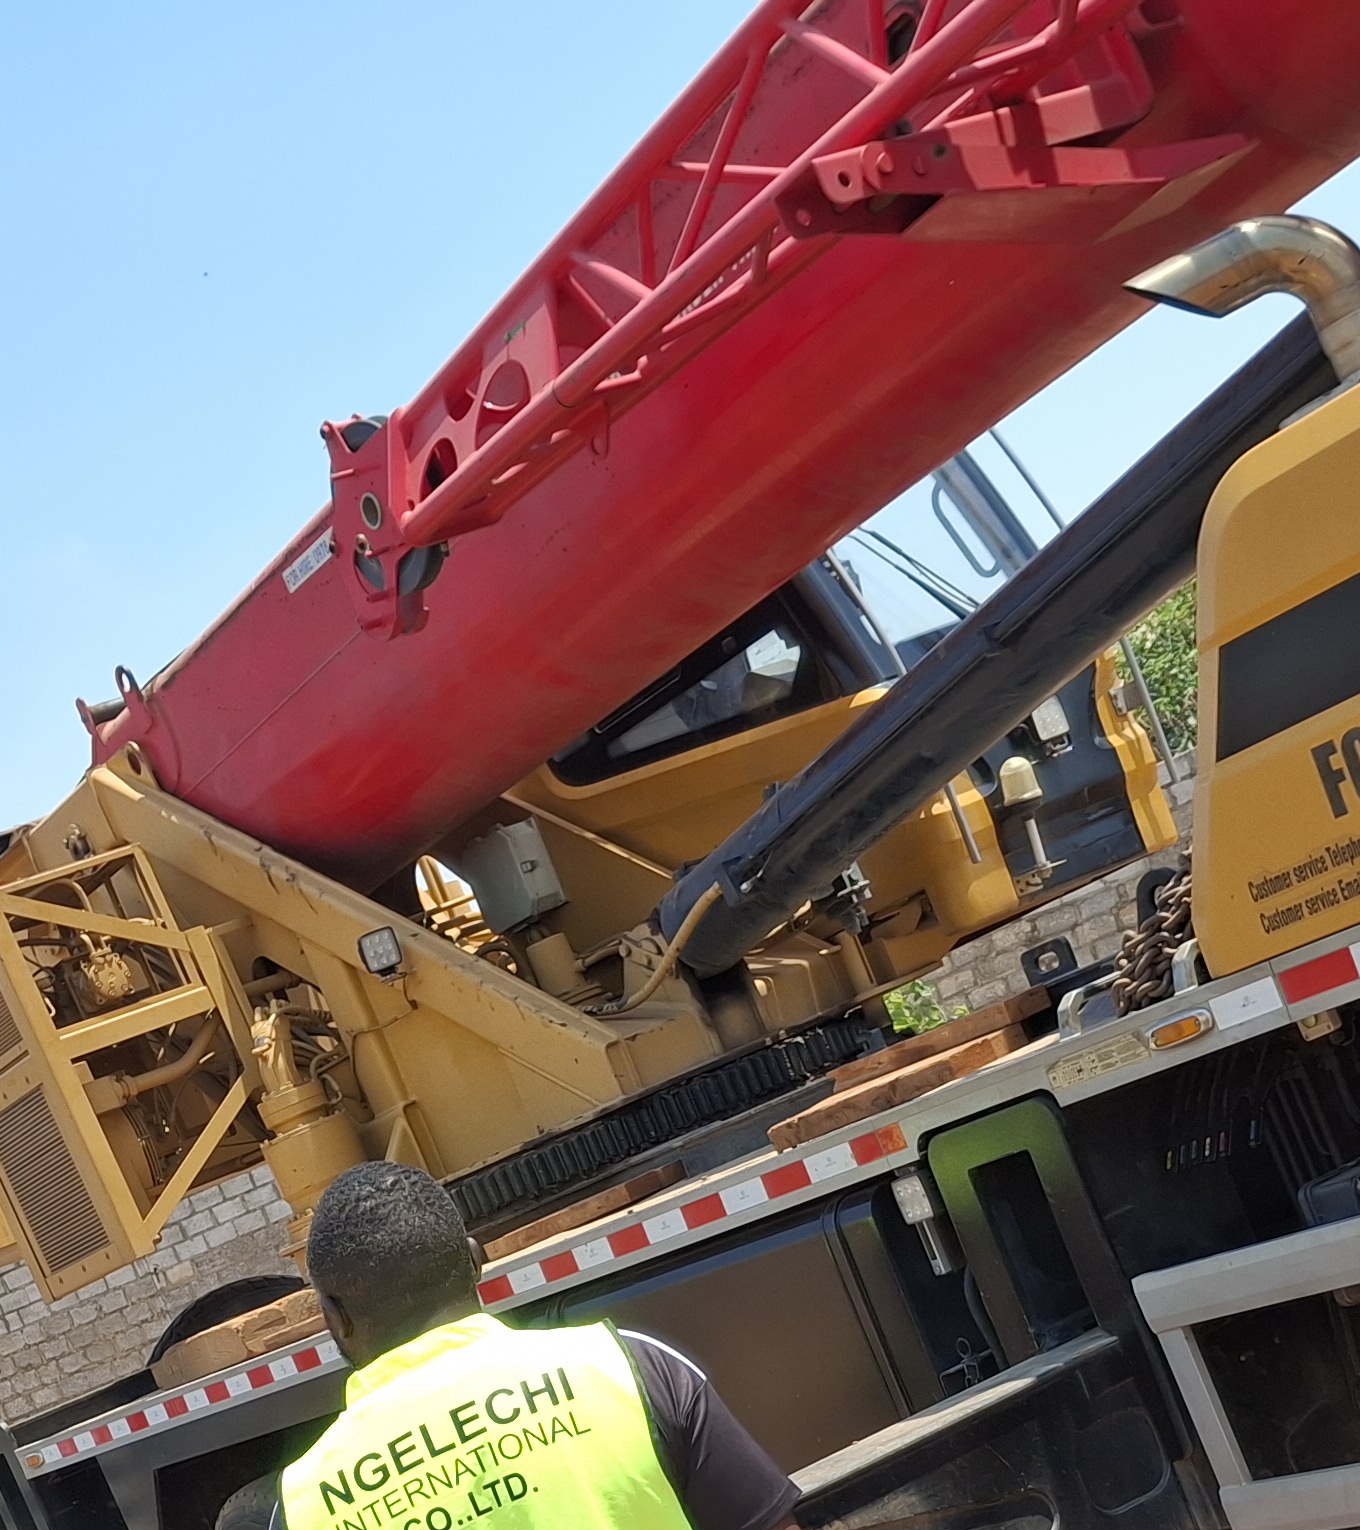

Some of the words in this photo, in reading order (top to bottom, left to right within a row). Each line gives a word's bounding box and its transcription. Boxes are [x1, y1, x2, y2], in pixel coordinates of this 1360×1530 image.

[1247, 873, 1292, 902] Customer
[1293, 855, 1329, 884] service
[1259, 903, 1305, 934] Customer
[1305, 887, 1340, 915] service
[319, 1367, 575, 1516] NGELECHI
